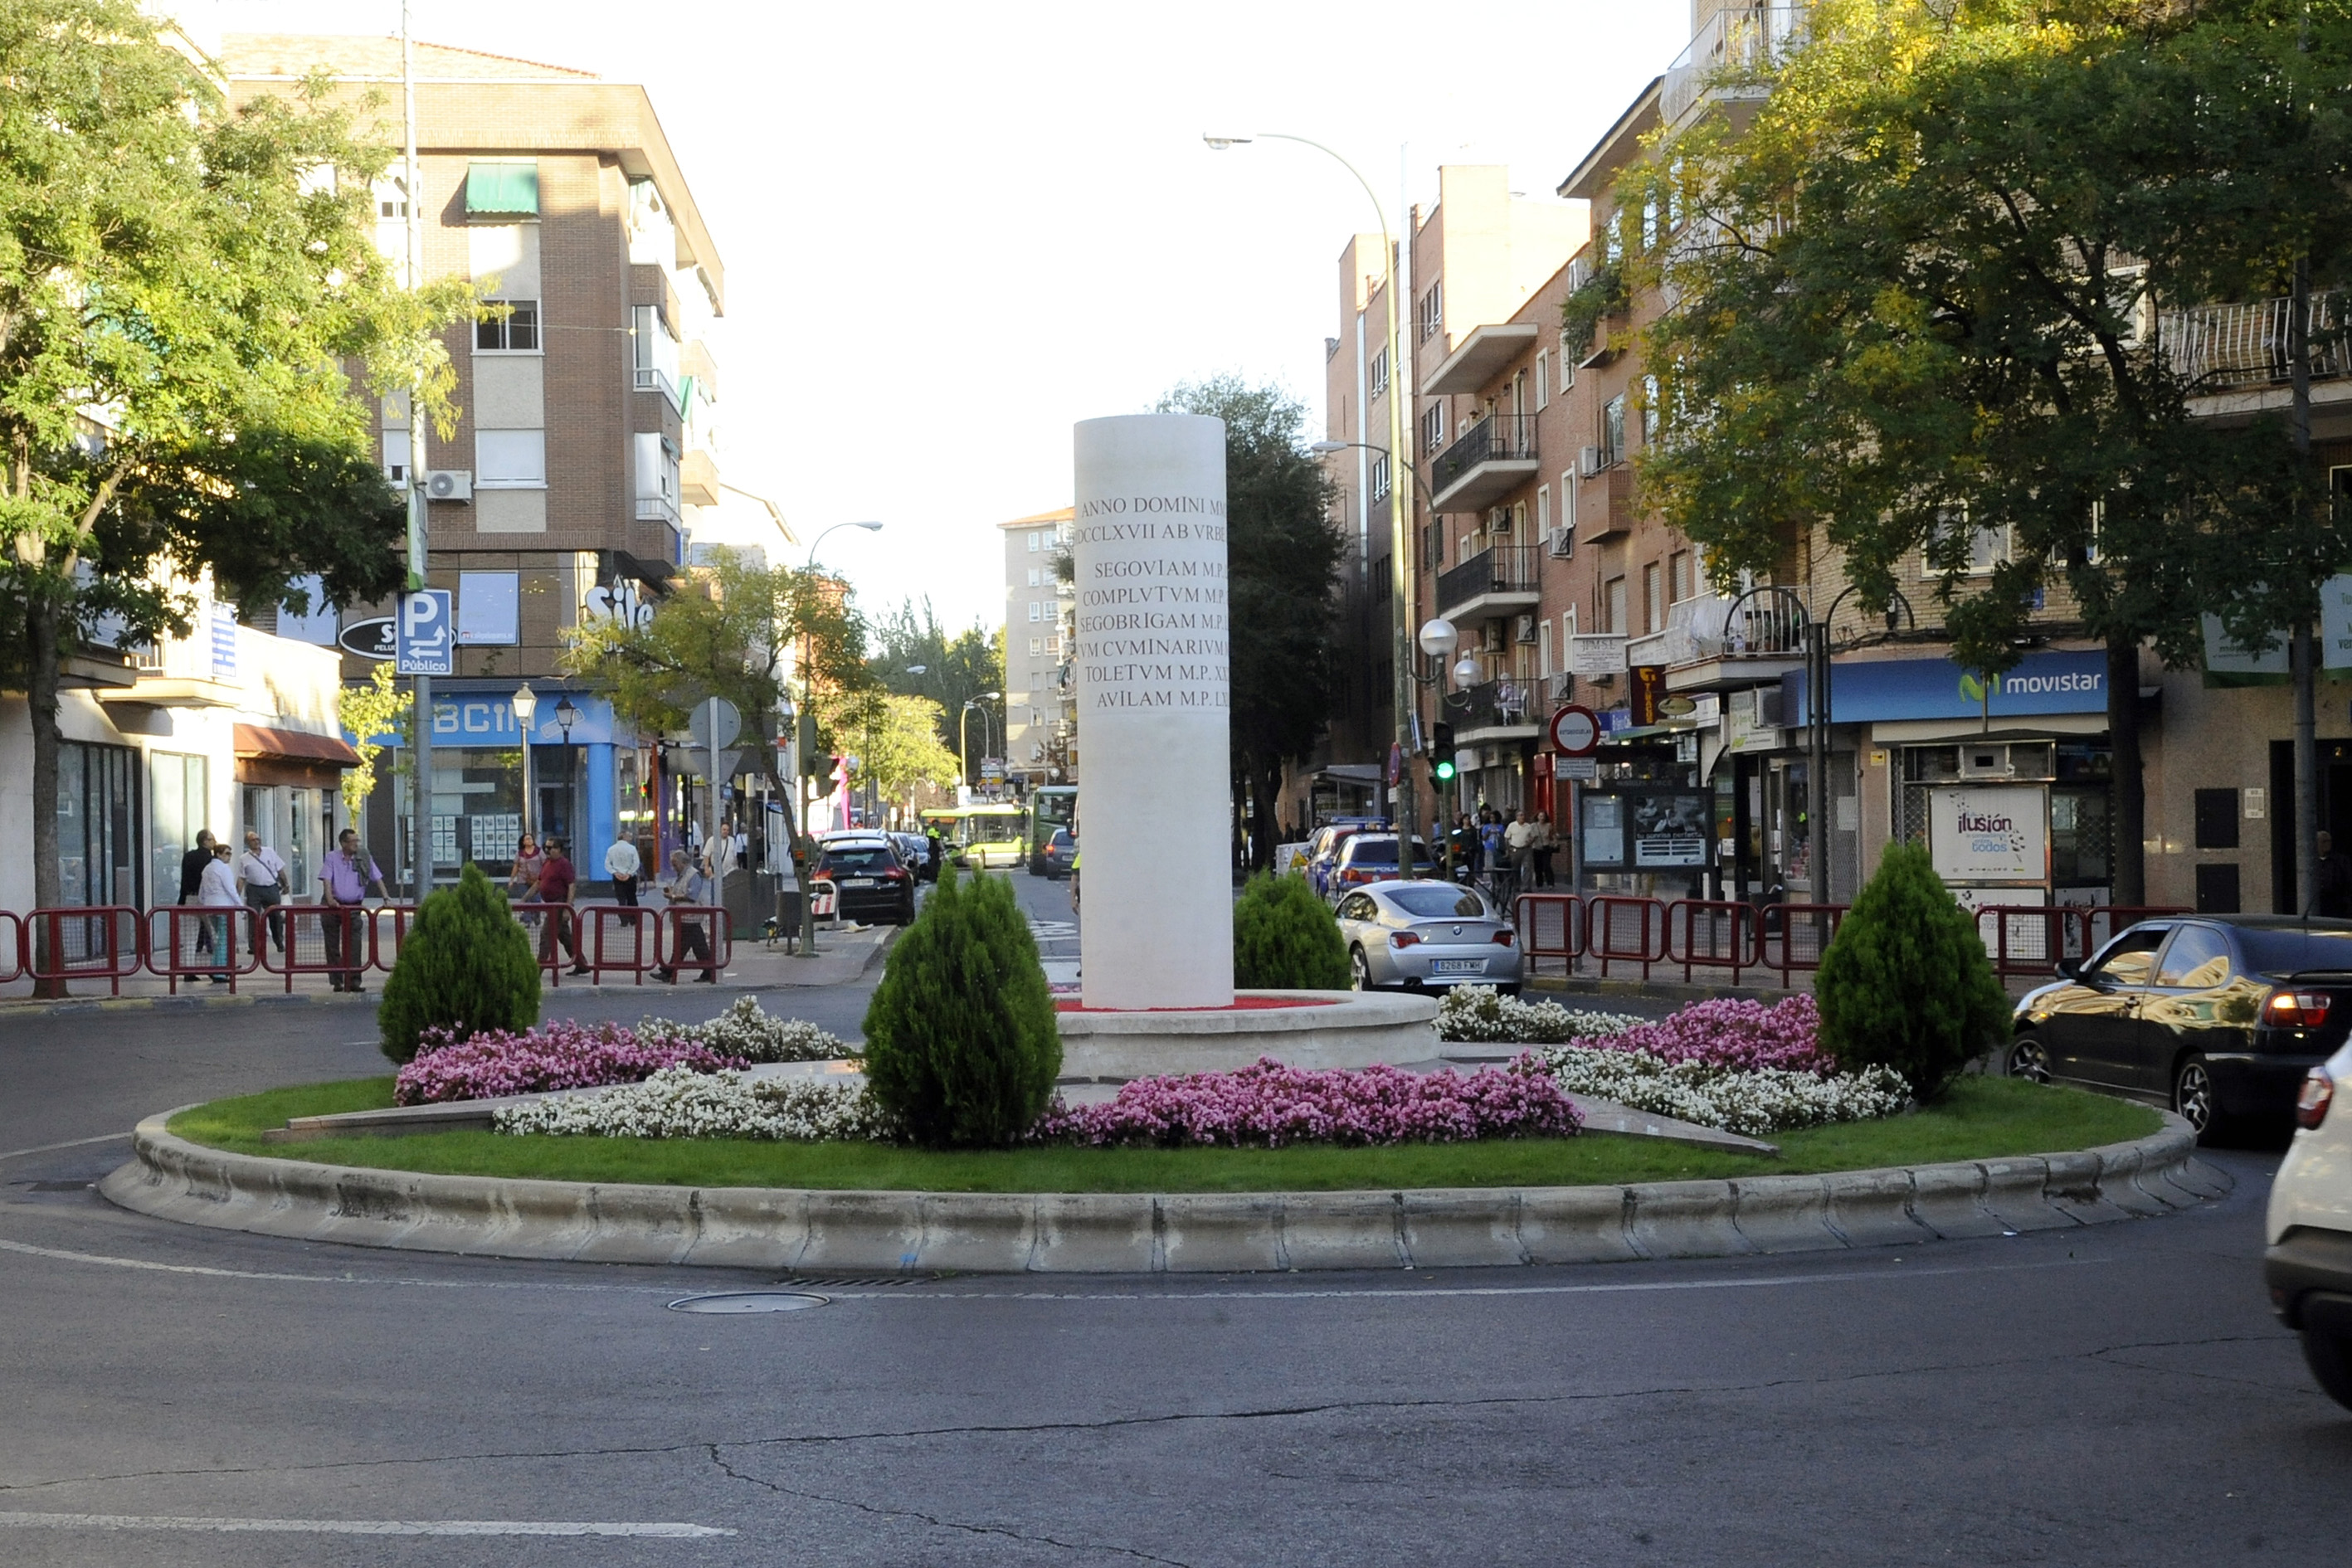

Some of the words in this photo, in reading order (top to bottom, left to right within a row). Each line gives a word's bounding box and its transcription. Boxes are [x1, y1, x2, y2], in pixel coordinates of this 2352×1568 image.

[1081, 498, 1127, 518] ANNO
[1134, 496, 1205, 514] DOMINI
[1161, 523, 1189, 539] AB
[1194, 524, 1225, 543] VRBE
[1094, 559, 1197, 579] SEGOVIAM
[1083, 586, 1200, 607] COMPLVTVM
[404, 592, 439, 637] P
[1080, 613, 1195, 633] SEGOBRIGAM
[381, 624, 396, 643] S
[1103, 639, 1224, 658] CVMINARIVM
[402, 660, 447, 672] Público
[1085, 664, 1172, 683] TOLETVM
[1180, 665, 1212, 681] M.P.
[2006, 672, 2101, 694] movistar
[1097, 690, 1172, 708] AVILAM
[1180, 691, 1212, 707] M.P.
[1958, 813, 2012, 833] ilusión
[1972, 841, 2008, 852] todos
[1440, 962, 1462, 970] 8268
